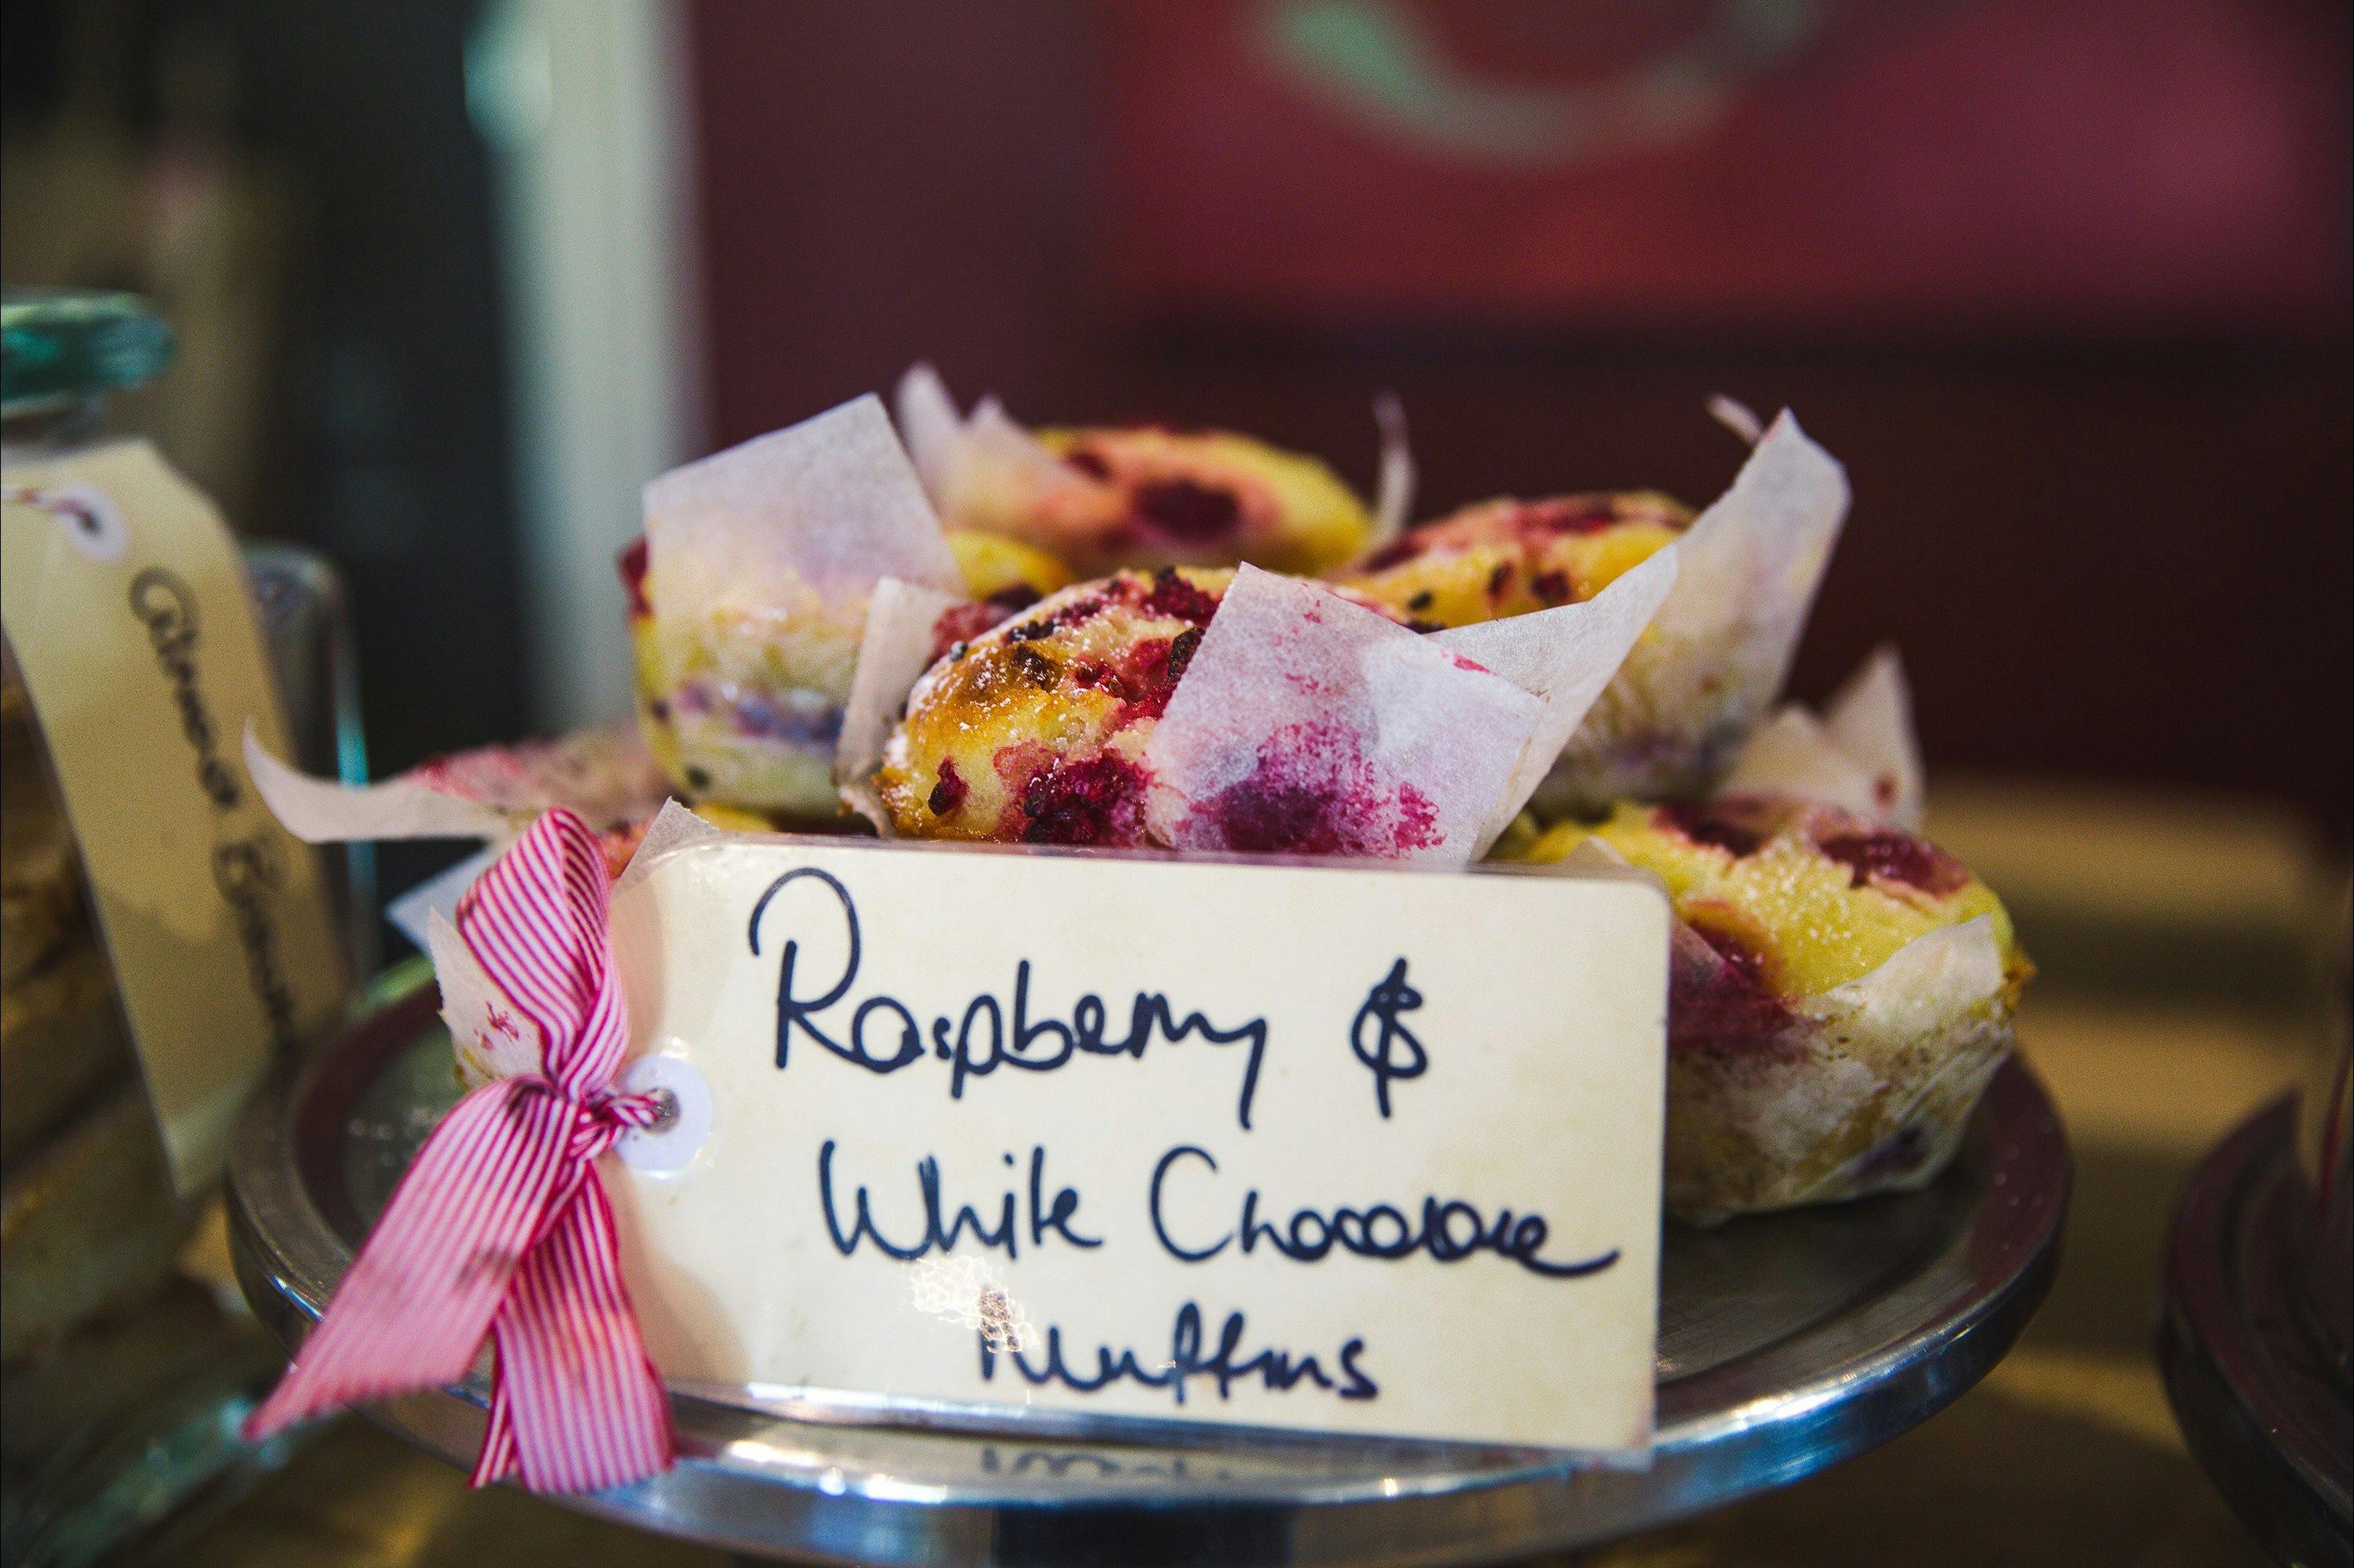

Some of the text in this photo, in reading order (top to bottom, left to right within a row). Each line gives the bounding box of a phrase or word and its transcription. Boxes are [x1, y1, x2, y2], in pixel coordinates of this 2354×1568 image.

[748, 866, 1267, 1130] Raspberry
[819, 1139, 1622, 1279] White Chocolate
[977, 1284, 1379, 1406] Muffins
